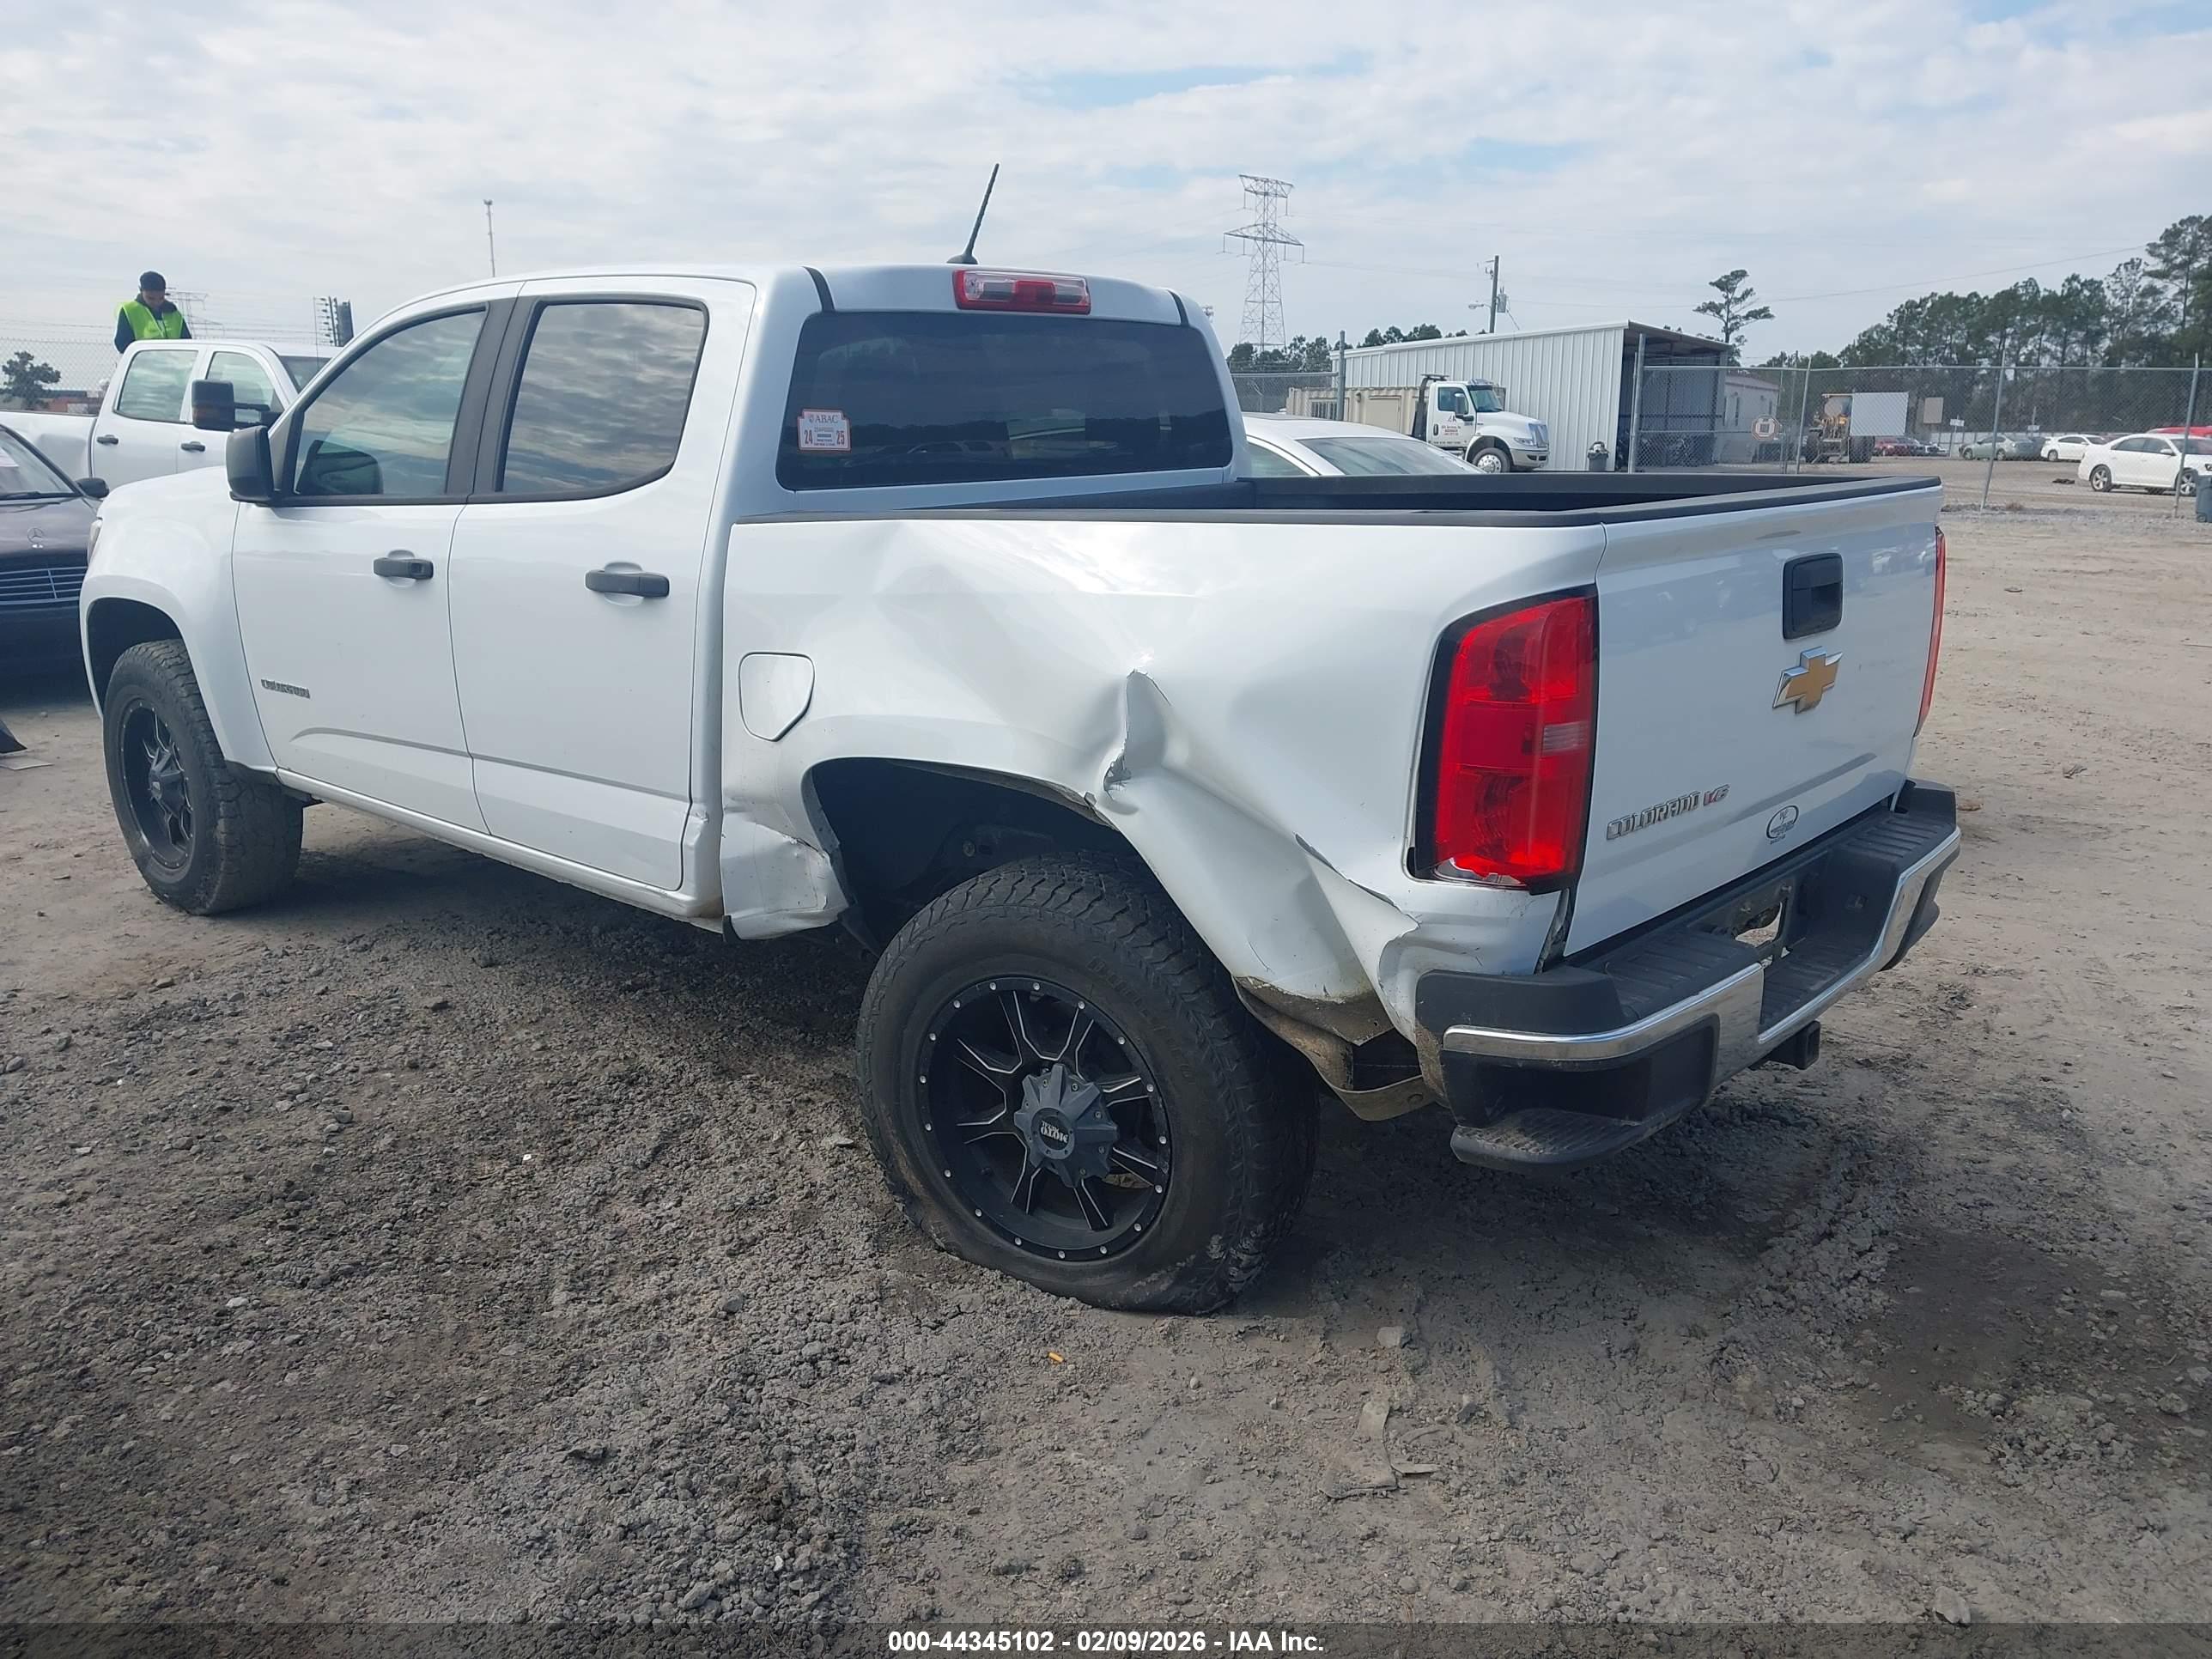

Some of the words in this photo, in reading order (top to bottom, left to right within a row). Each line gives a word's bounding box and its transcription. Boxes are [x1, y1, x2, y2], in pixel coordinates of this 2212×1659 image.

[804, 429, 812, 445] 24
[836, 430, 845, 445] 25
[1606, 790, 1700, 840] COLORADO
[1703, 783, 1730, 806] V6
